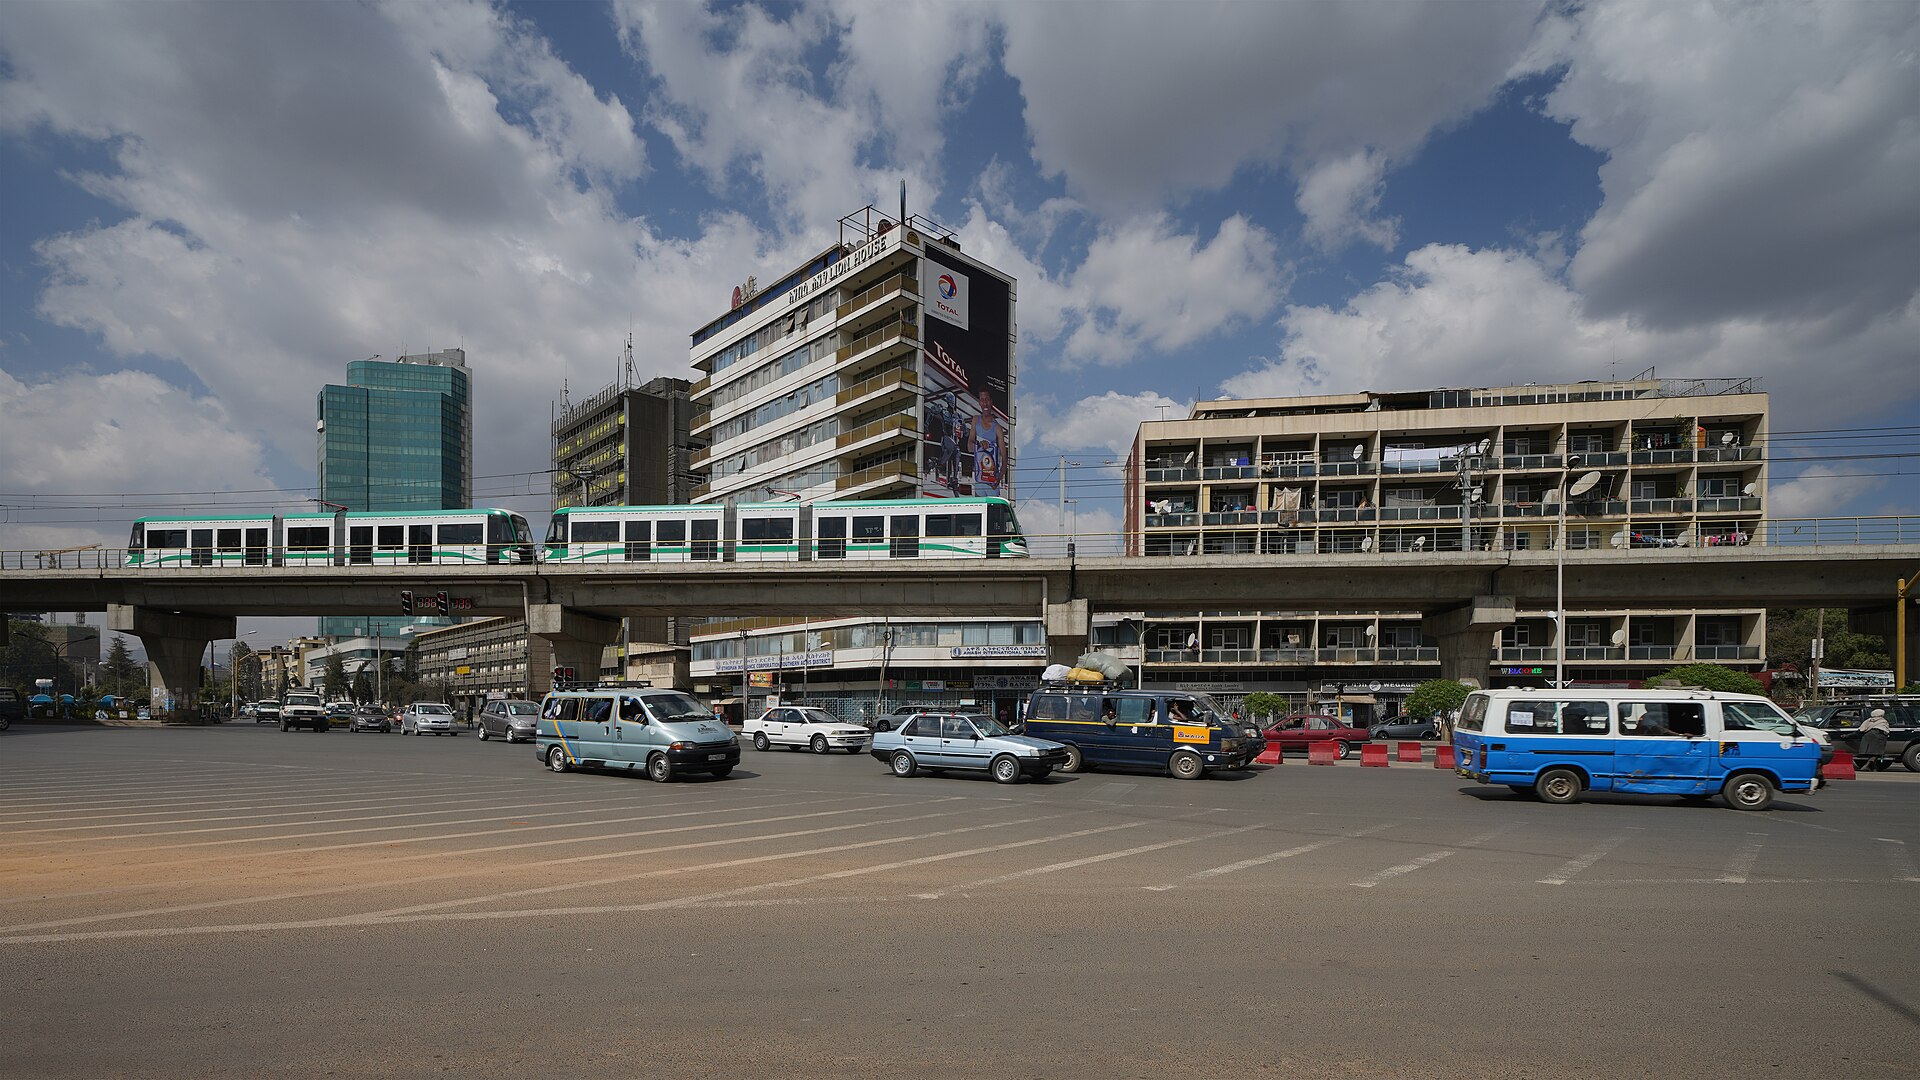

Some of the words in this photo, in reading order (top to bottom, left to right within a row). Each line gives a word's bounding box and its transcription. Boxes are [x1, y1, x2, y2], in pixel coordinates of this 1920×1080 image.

[830, 257, 851, 281] LION
[854, 235, 887, 266] HOUSE
[936, 300, 959, 316] TOTAL
[933, 340, 969, 381] TOTAL
[1500, 667, 1543, 675] WELCOME
